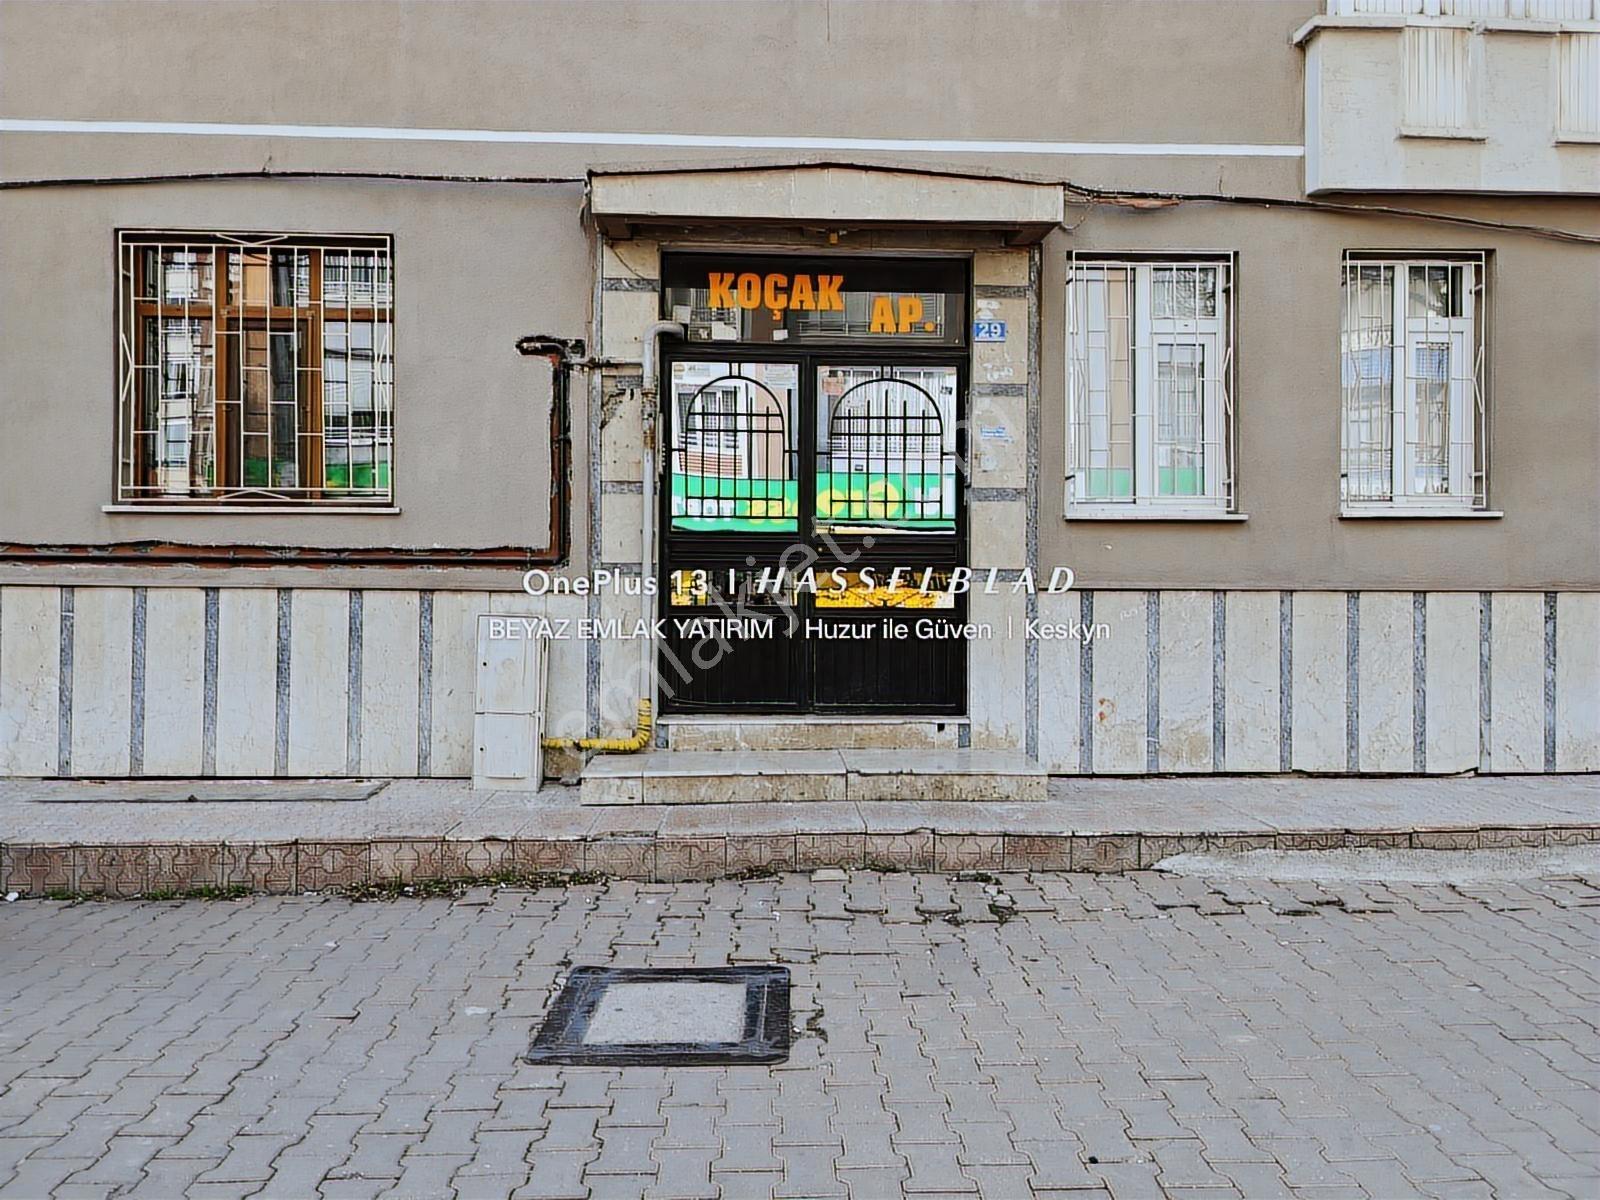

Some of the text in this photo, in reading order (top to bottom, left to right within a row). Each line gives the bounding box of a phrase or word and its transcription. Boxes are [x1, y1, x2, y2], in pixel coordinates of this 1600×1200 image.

[708, 272, 935, 334] KOÇAK AP.
[977, 322, 1002, 338] 29
